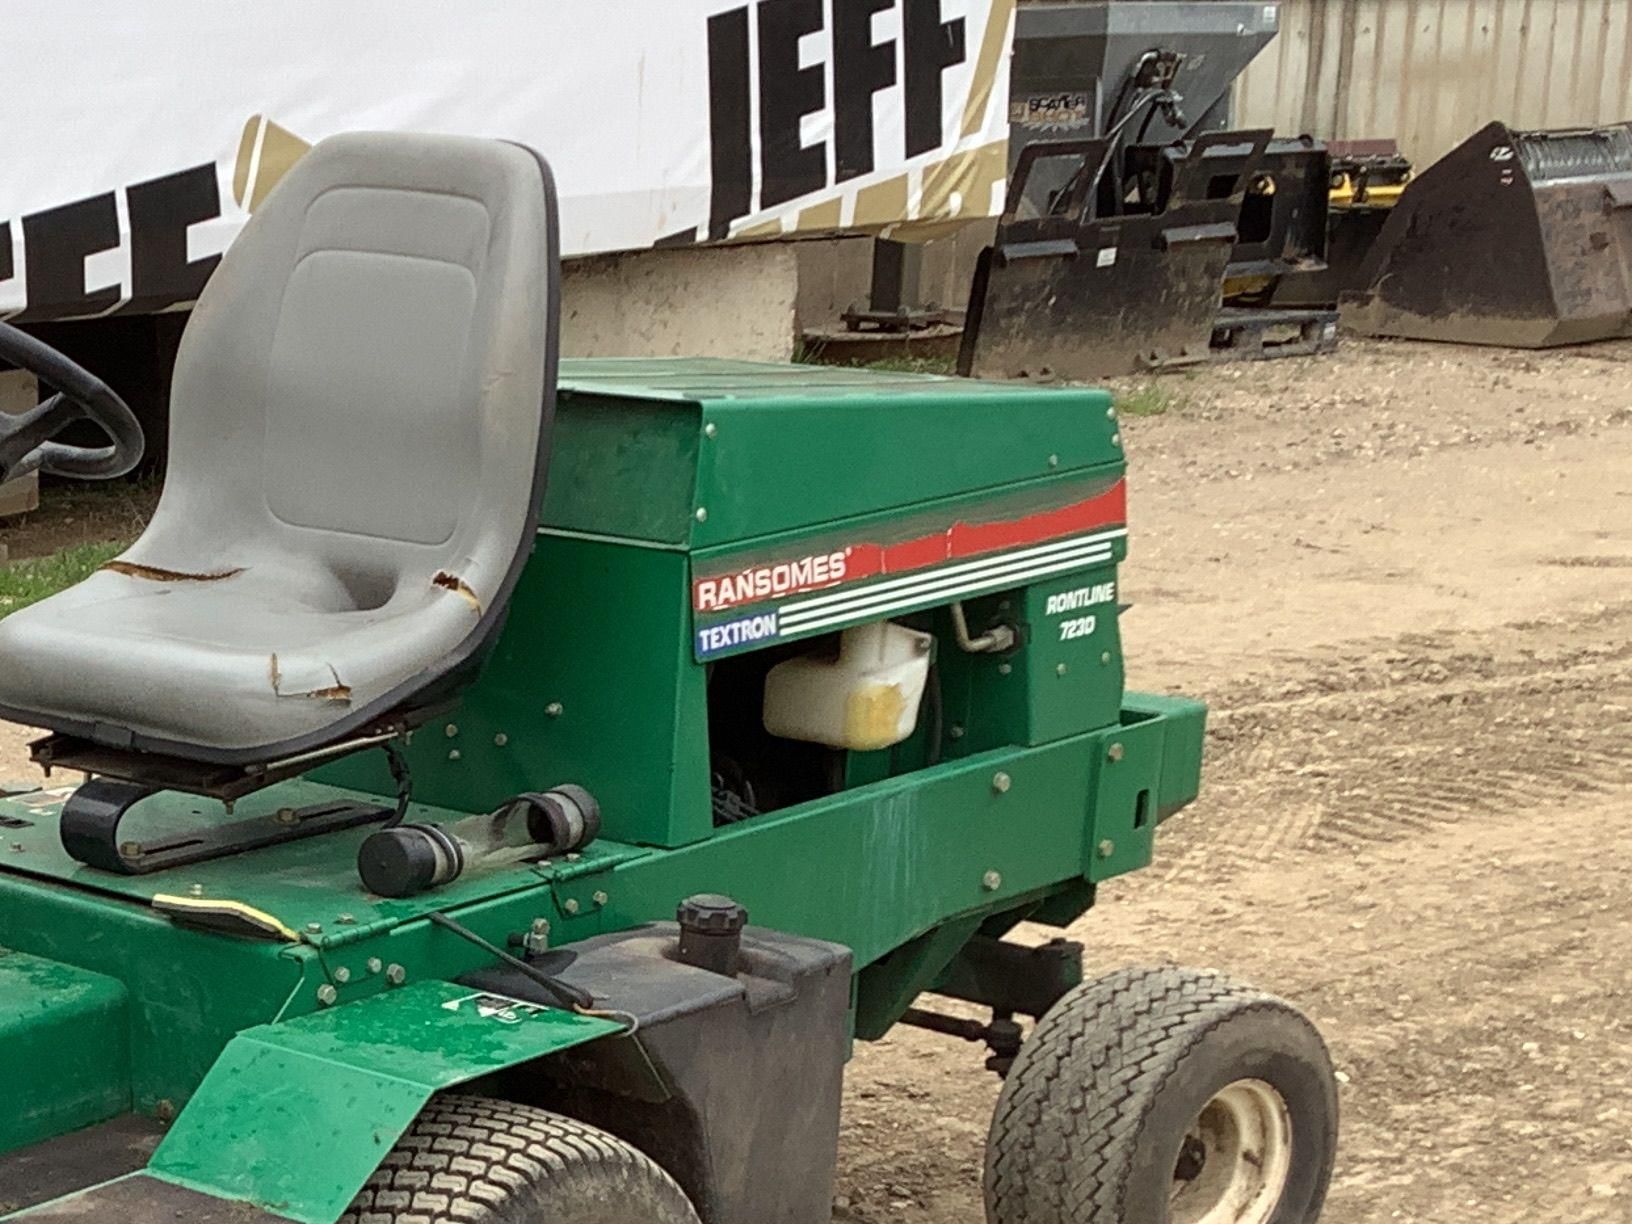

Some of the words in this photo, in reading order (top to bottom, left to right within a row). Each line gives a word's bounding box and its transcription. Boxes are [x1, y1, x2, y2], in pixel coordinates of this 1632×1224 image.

[698, 549, 848, 610] RANSOMES
[699, 613, 777, 652] TEXTRON
[1058, 615, 1096, 640] 723D
